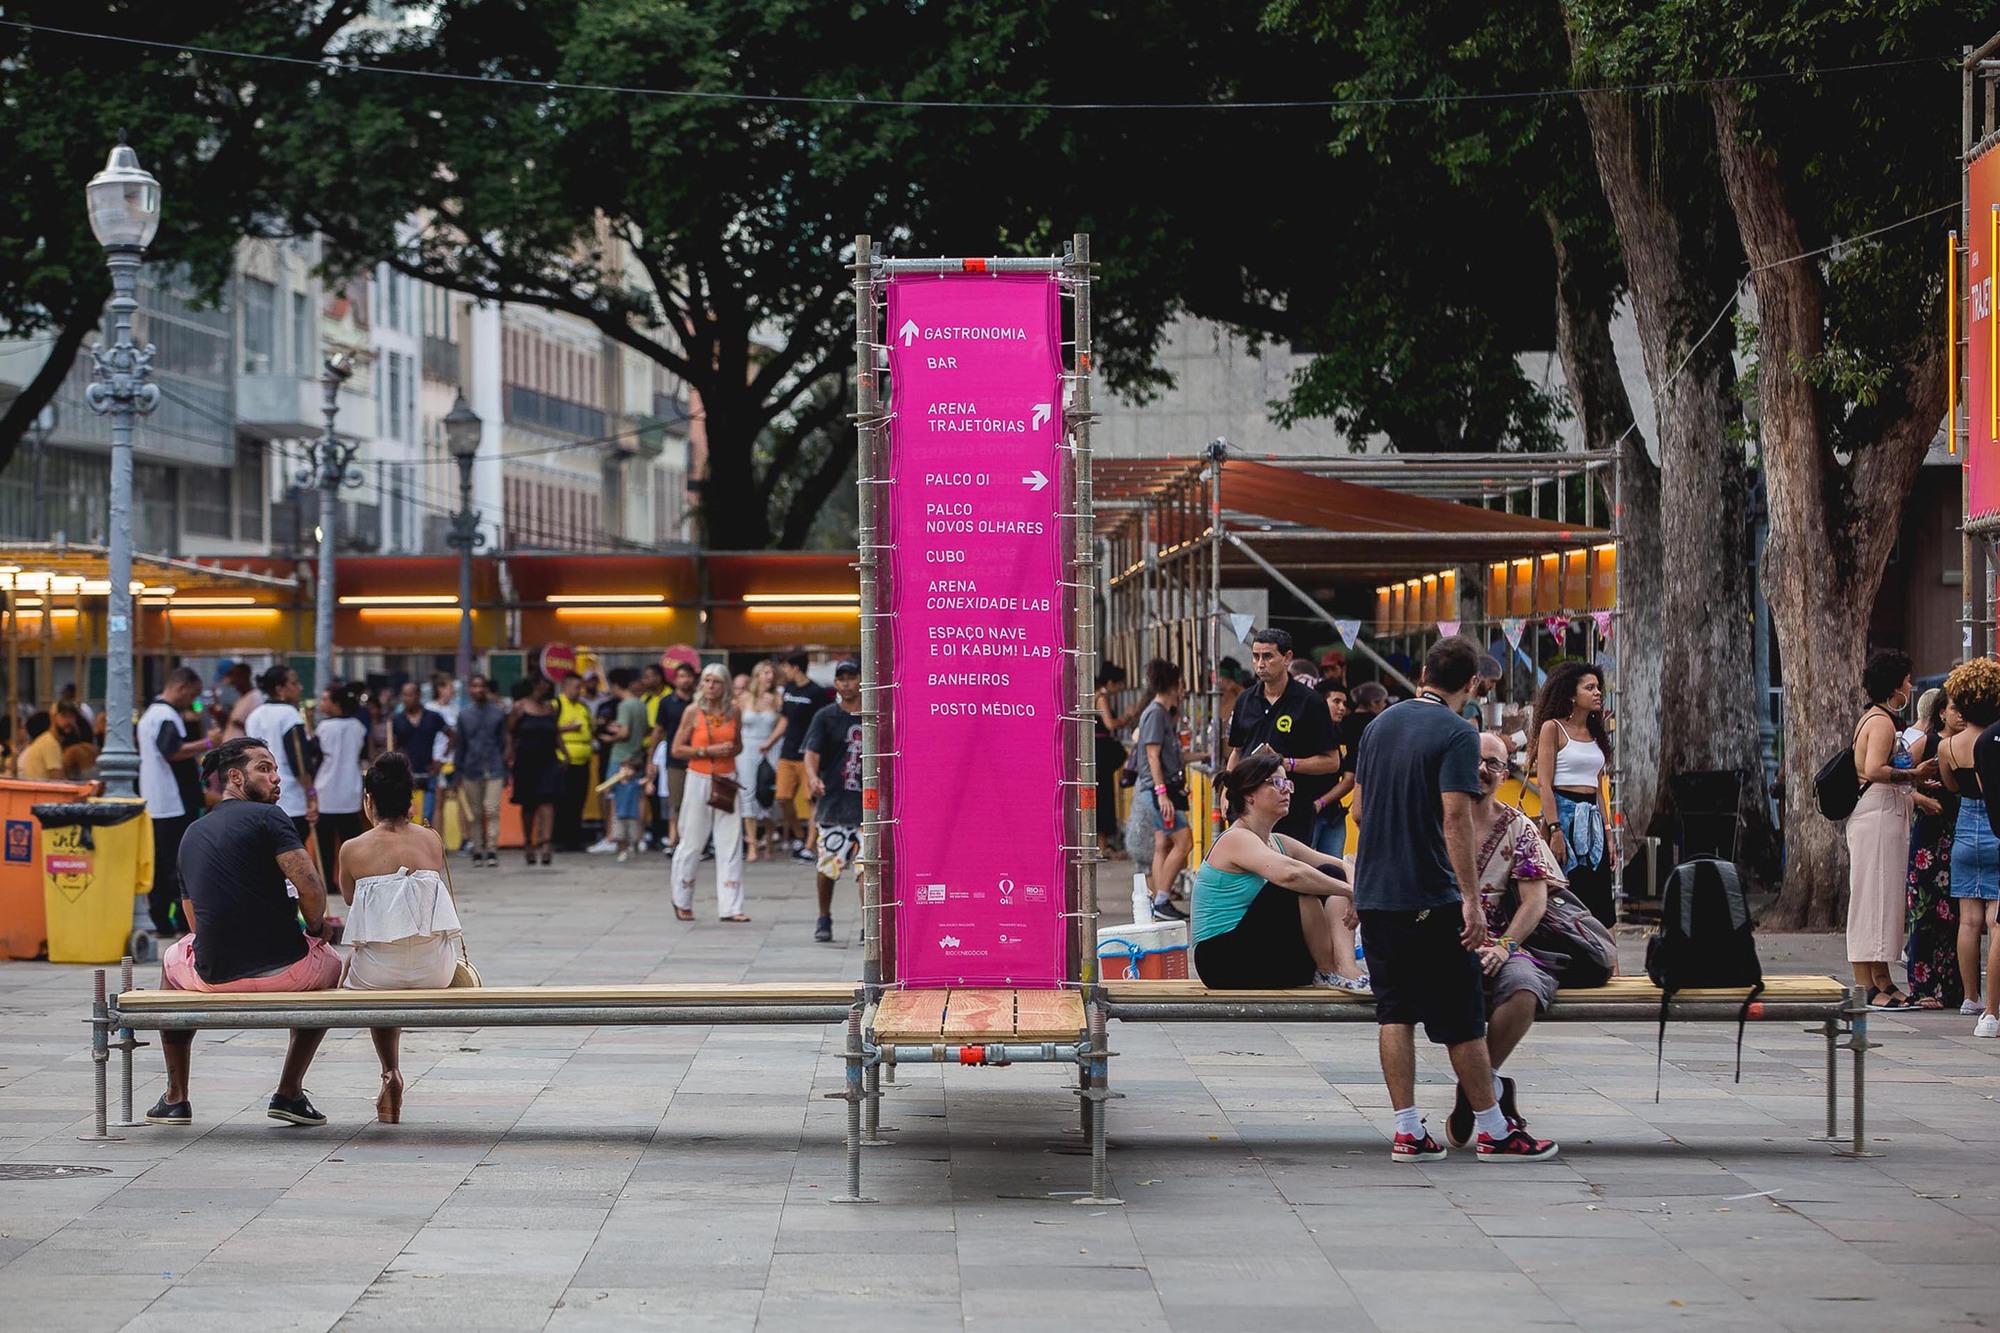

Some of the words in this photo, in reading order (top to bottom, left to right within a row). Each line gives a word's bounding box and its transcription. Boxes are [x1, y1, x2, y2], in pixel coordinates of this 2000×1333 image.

[925, 327, 1026, 339] GASTRONOMIA
[927, 357, 957, 368] BAR
[928, 403, 976, 414] ARENA
[928, 418, 1025, 432] TRAJETÓRIAS
[926, 474, 971, 485] PALCO
[927, 504, 972, 515] PALCO
[927, 521, 973, 532] NOVOS
[979, 521, 1043, 534] OLHARES
[927, 551, 964, 562] CUBO
[929, 581, 976, 592] ARENA
[927, 598, 1017, 609] CONEXIDADE
[1023, 599, 1049, 611] LAB
[929, 627, 984, 640] ESPAÇO
[989, 628, 1026, 639] NAVE
[931, 644, 938, 655] E
[962, 644, 1017, 656] KABUM!
[1023, 645, 1050, 657] LAB
[929, 674, 1009, 685] BANHEIROS
[931, 703, 976, 715] POSTO
[982, 702, 1034, 716] MÉDICO
